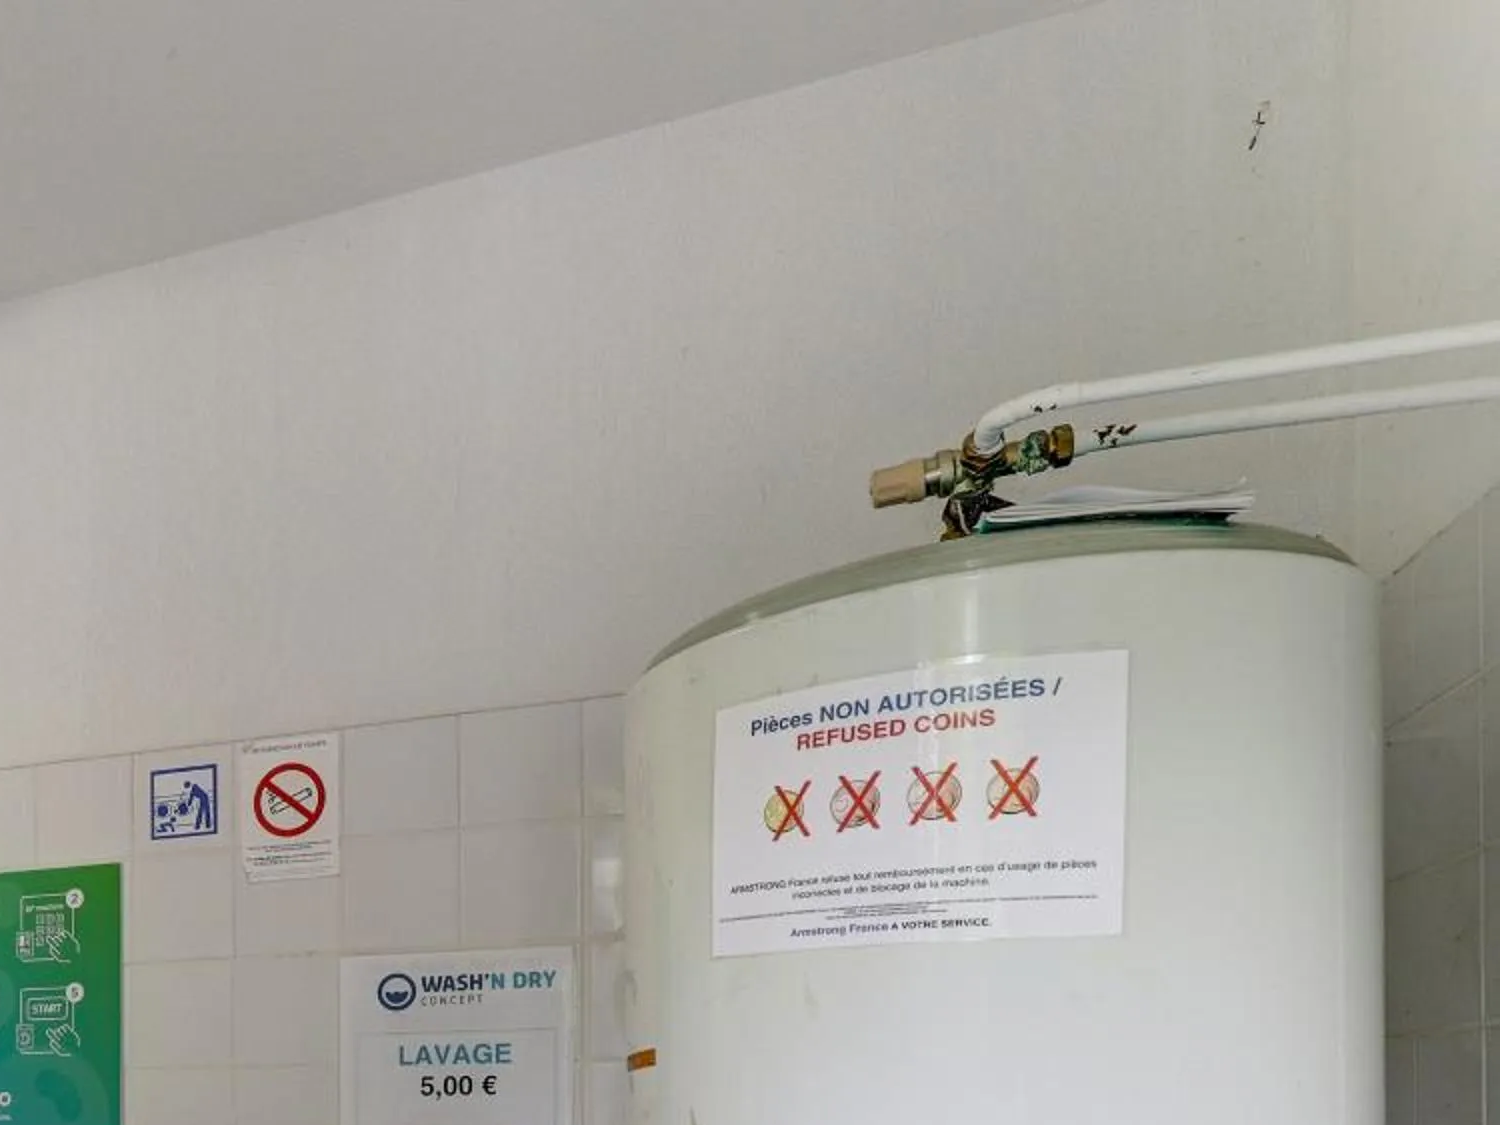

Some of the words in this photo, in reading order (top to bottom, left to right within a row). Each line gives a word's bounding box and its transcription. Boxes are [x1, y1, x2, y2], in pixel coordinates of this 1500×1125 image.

[750, 712, 813, 737] Pièces
[818, 698, 871, 723] NON
[877, 676, 1046, 714] AUTORISÉES
[796, 718, 907, 751] REFUSED
[914, 708, 996, 733] COINS
[729, 879, 787, 895] ARMSTRONG
[788, 876, 819, 888] France
[957, 864, 973, 874] en
[1044, 860, 1059, 870] de
[790, 925, 847, 938] Armstrong
[849, 922, 890, 934] France
[891, 921, 899, 930] A
[901, 919, 938, 931] VOTRE
[421, 971, 505, 993] WASH'N
[513, 970, 556, 990] DRY
[31, 1002, 63, 1015] START
[420, 994, 483, 1007] CONCEPT
[398, 1042, 513, 1067] LAVAGE
[420, 1075, 473, 1100] 5,00
[482, 1075, 497, 1097] €
